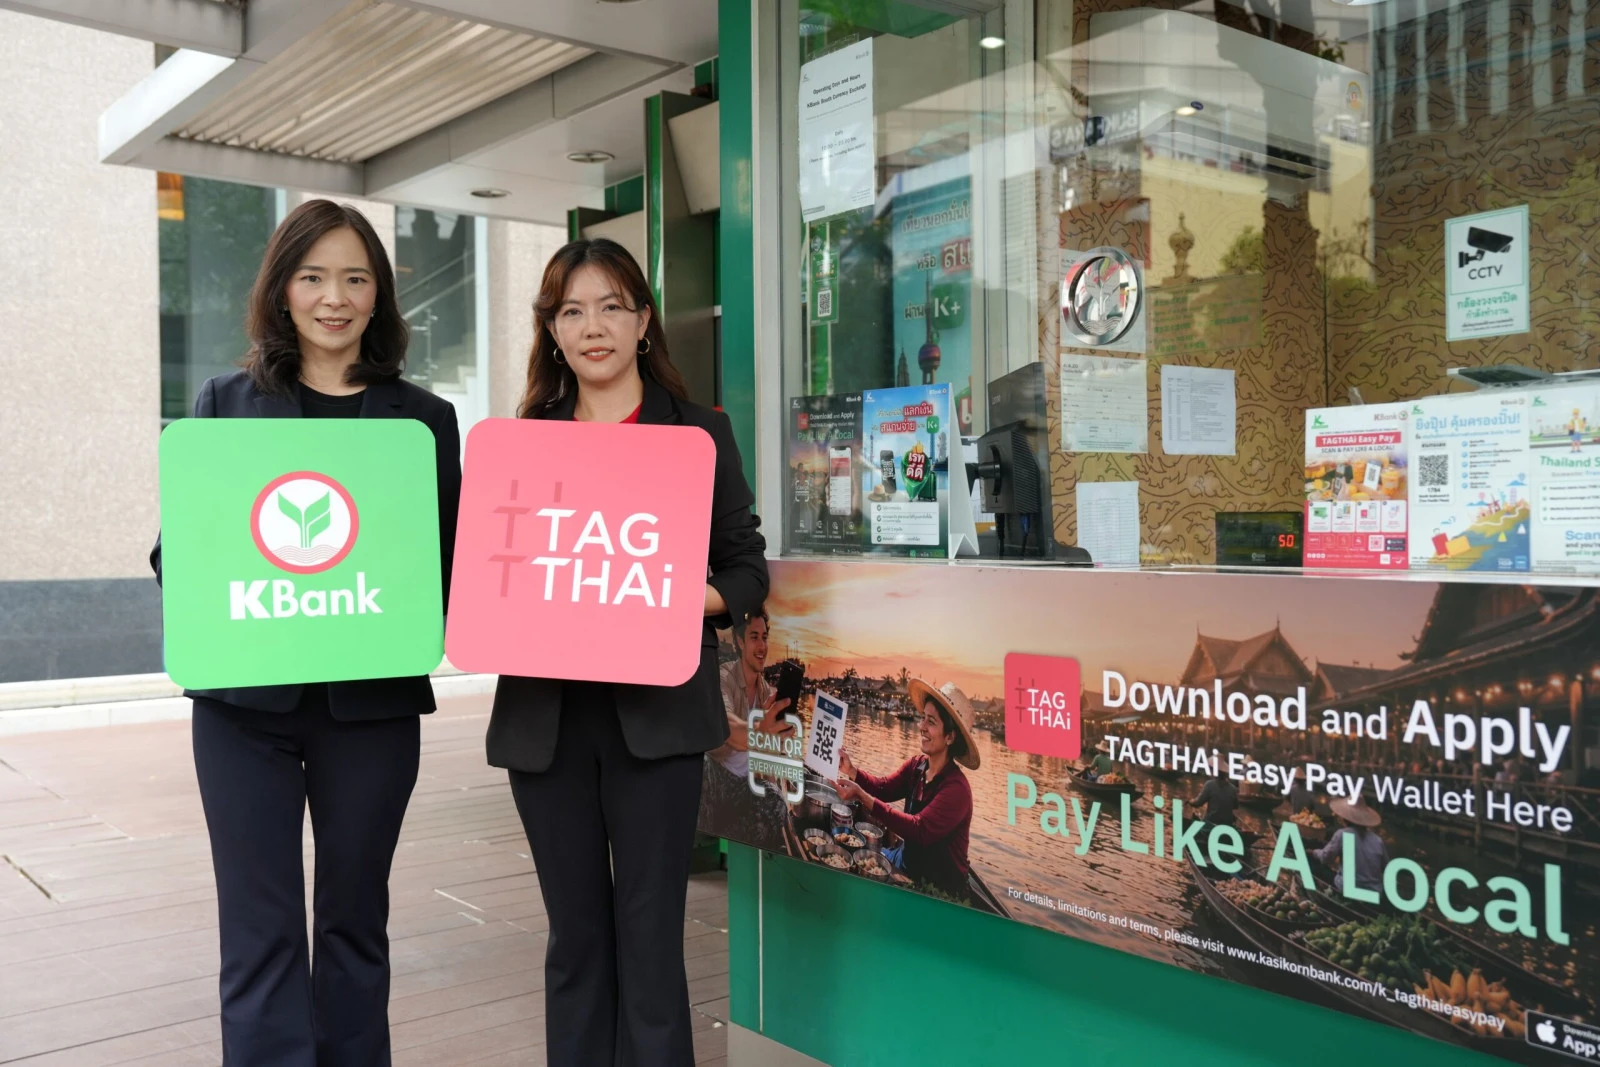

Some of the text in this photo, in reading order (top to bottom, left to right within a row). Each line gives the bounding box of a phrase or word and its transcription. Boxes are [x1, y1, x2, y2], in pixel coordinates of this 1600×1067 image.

[1468, 265, 1503, 280] CCTV
[934, 297, 961, 318] K+
[1457, 291, 1517, 309] กล้องวงจรปิด
[810, 412, 832, 420] Download
[841, 411, 855, 420] Apply
[904, 402, 933, 416] แลกเงิน
[1374, 413, 1397, 421] KBank
[880, 417, 916, 433] สแกนจ่าย
[927, 421, 938, 429] K+
[1322, 434, 1395, 445] TAGTHAi Easy Pay
[908, 452, 925, 463] เรท
[1540, 455, 1592, 467] Thailand
[536, 508, 660, 557] TAG
[1279, 534, 1295, 548] 50
[530, 556, 673, 608] THAi
[229, 571, 384, 621] KBank
[1026, 688, 1066, 710] TAG
[1027, 707, 1071, 731] THAi
[1102, 669, 1571, 773] Download and Apply
[748, 731, 802, 757] SCAN QR
[748, 759, 804, 781] EVERYWHERE
[1104, 734, 1573, 833] TAGTHAi Easy Pay Wallet Here
[1006, 772, 1570, 946] Pay Like A Local
[1008, 886, 1506, 1032] For details, limitations and terms, please visit www.kasikornbank.com/k_tagthaieasypay
[1562, 1034, 1597, 1058] App
